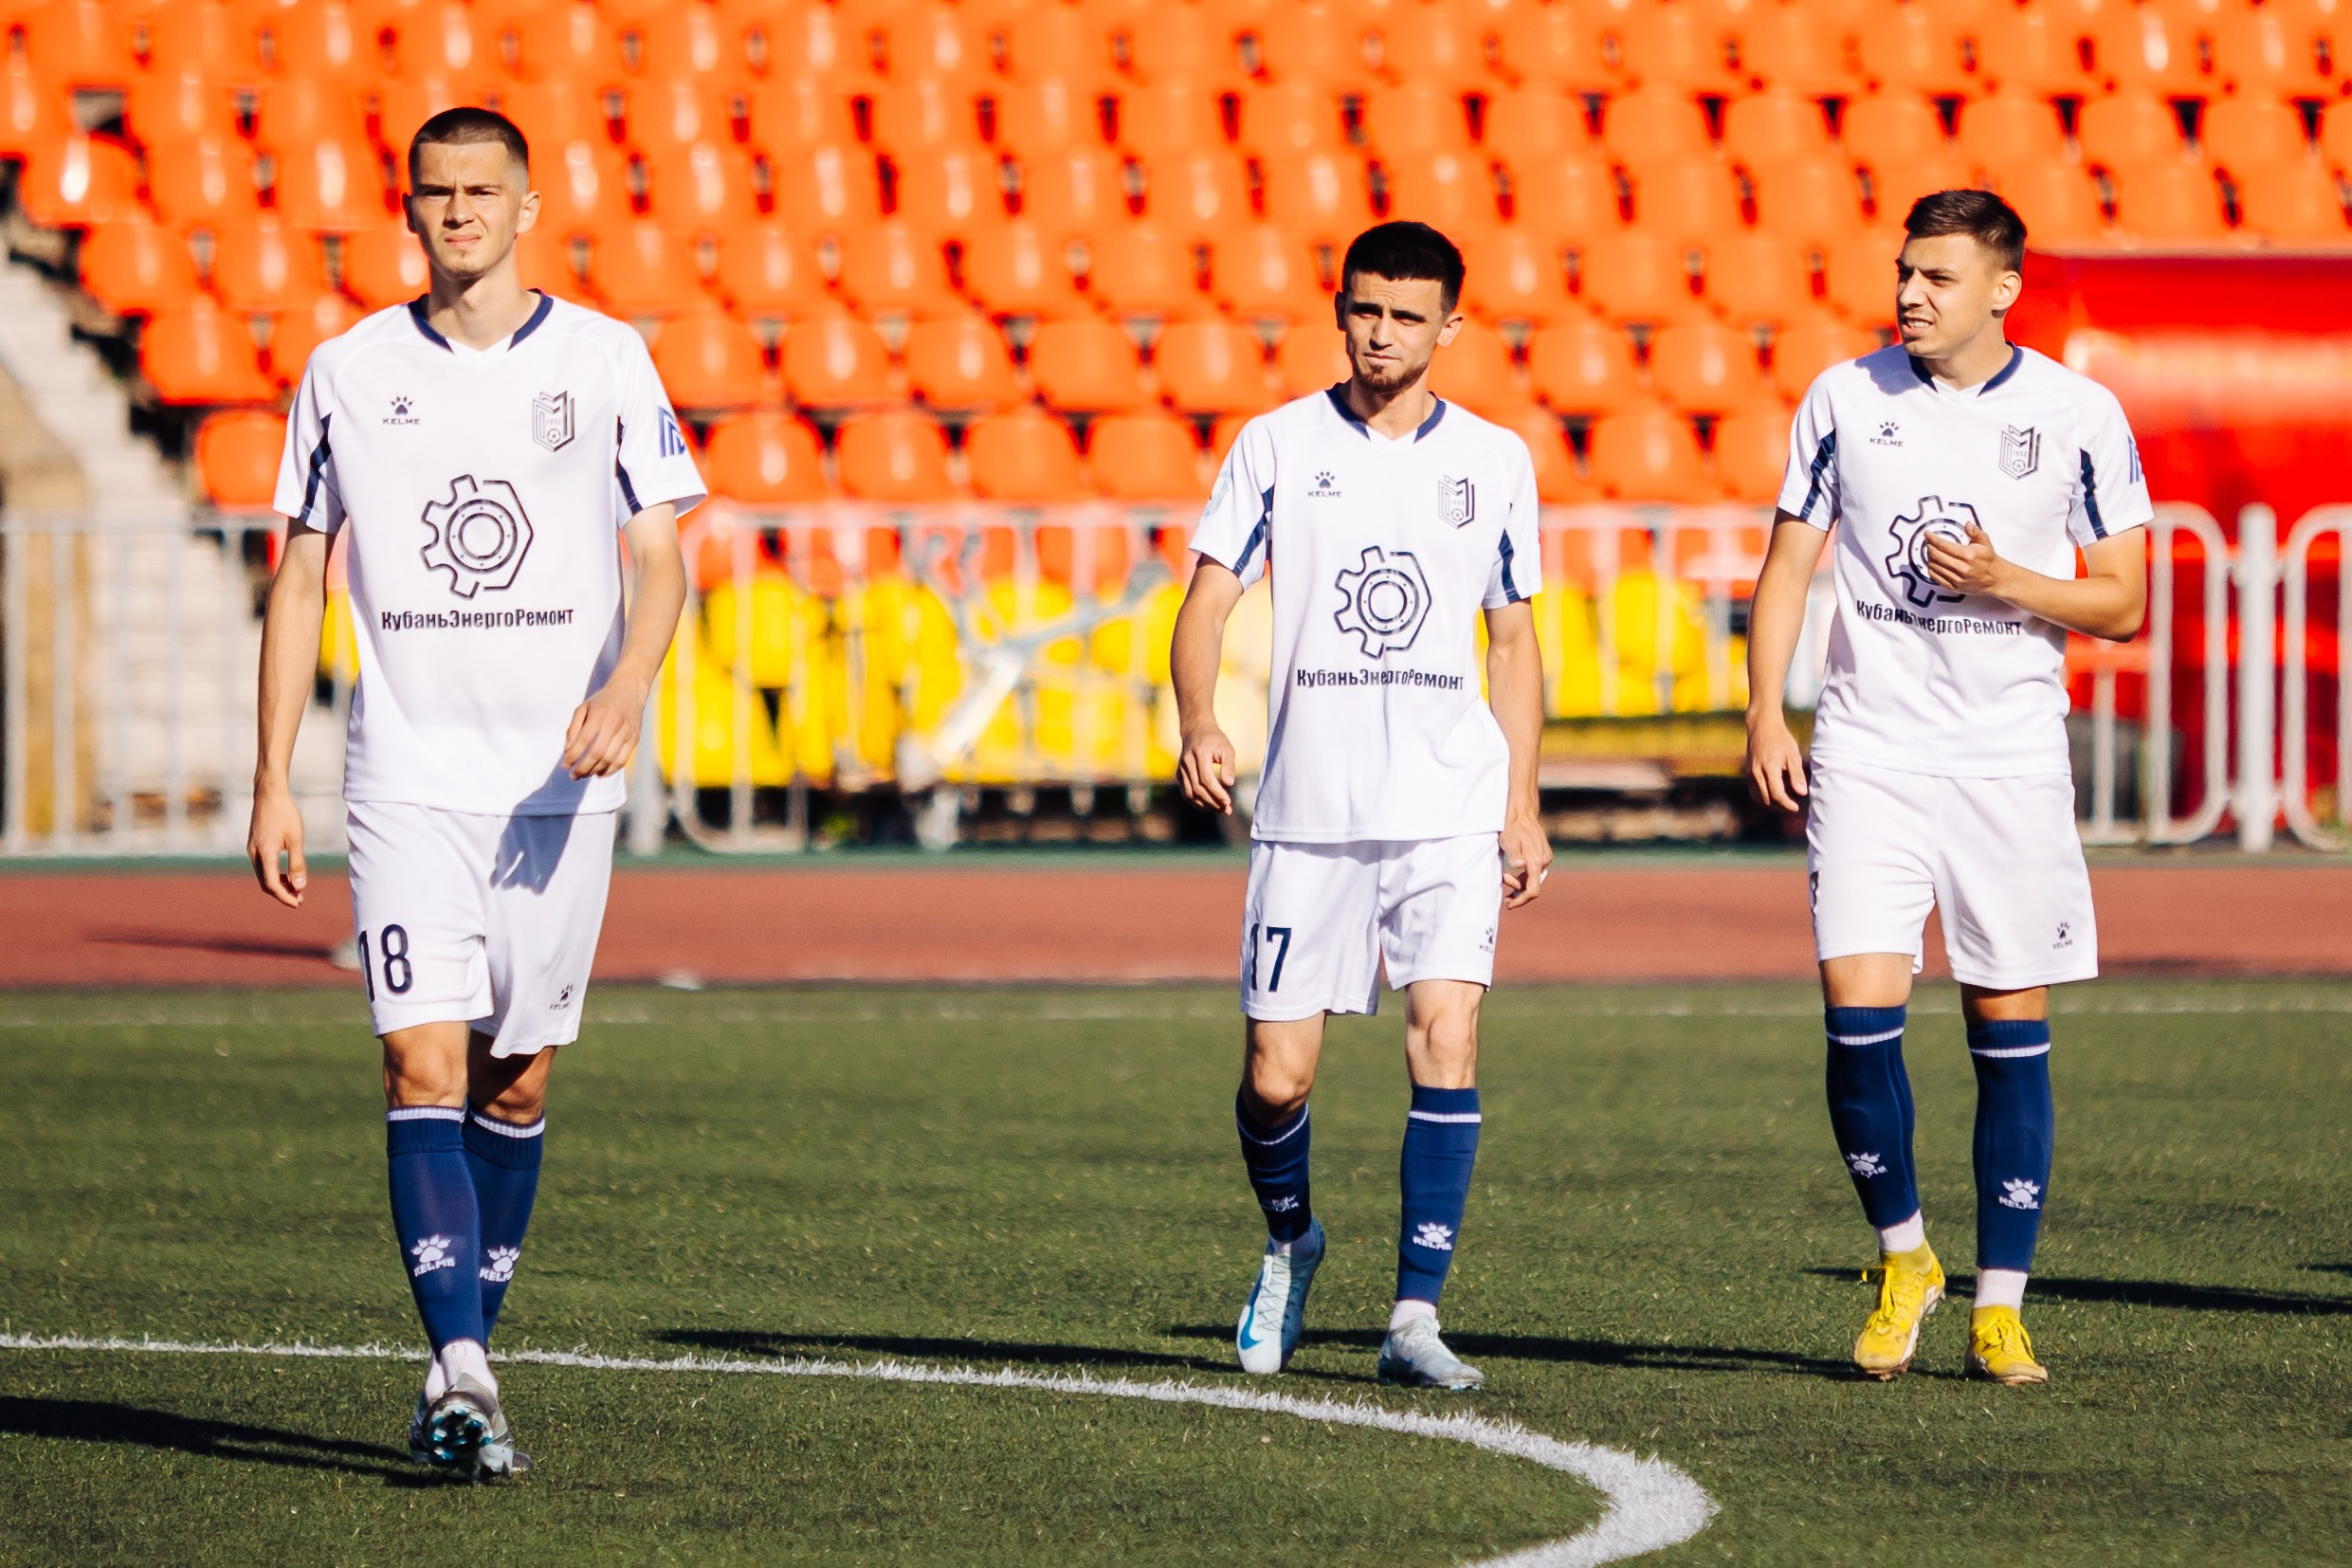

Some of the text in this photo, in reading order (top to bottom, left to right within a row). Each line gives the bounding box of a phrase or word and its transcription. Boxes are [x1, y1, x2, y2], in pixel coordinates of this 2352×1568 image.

[1869, 438, 1904, 447] KELME
[381, 609, 574, 631] КубаньЭнергоРемонт
[1297, 668, 1464, 691] КубаньЭнергоРемонт
[358, 923, 412, 1004] 18
[1250, 923, 1292, 993] 17
[413, 1256, 456, 1277] KELME
[479, 1267, 515, 1283] KELM
